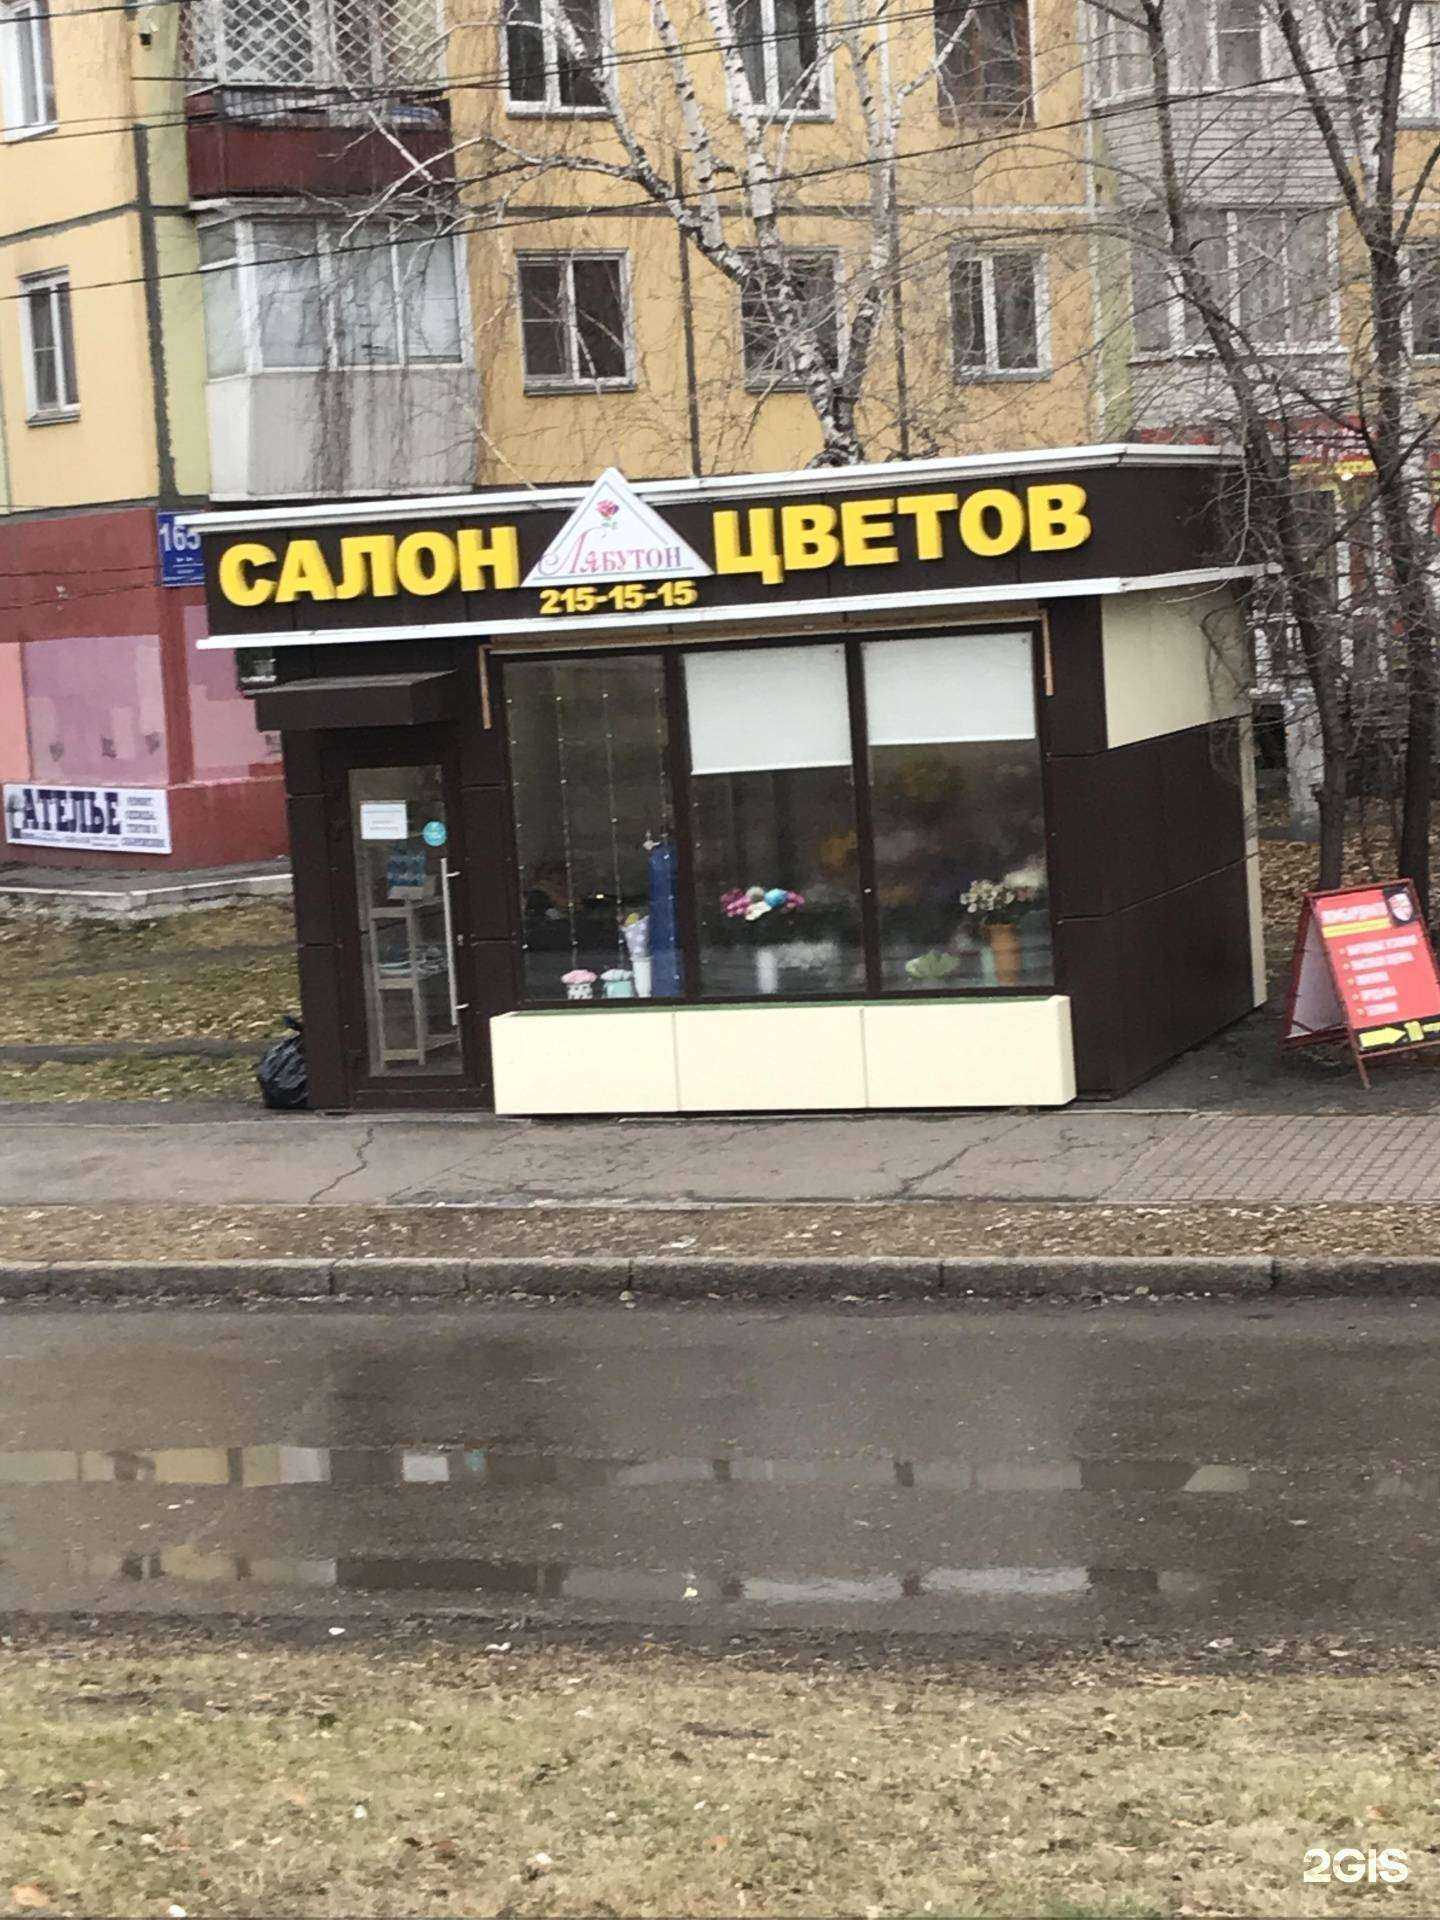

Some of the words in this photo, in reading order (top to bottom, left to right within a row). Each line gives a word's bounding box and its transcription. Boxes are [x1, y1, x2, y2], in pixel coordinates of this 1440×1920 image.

[218, 524, 521, 608] САЛОН
[713, 483, 1091, 586] ЦВЕТОВ
[539, 580, 698, 615] 215-15-15
[22, 788, 122, 834] АТЕЛЬЕ
